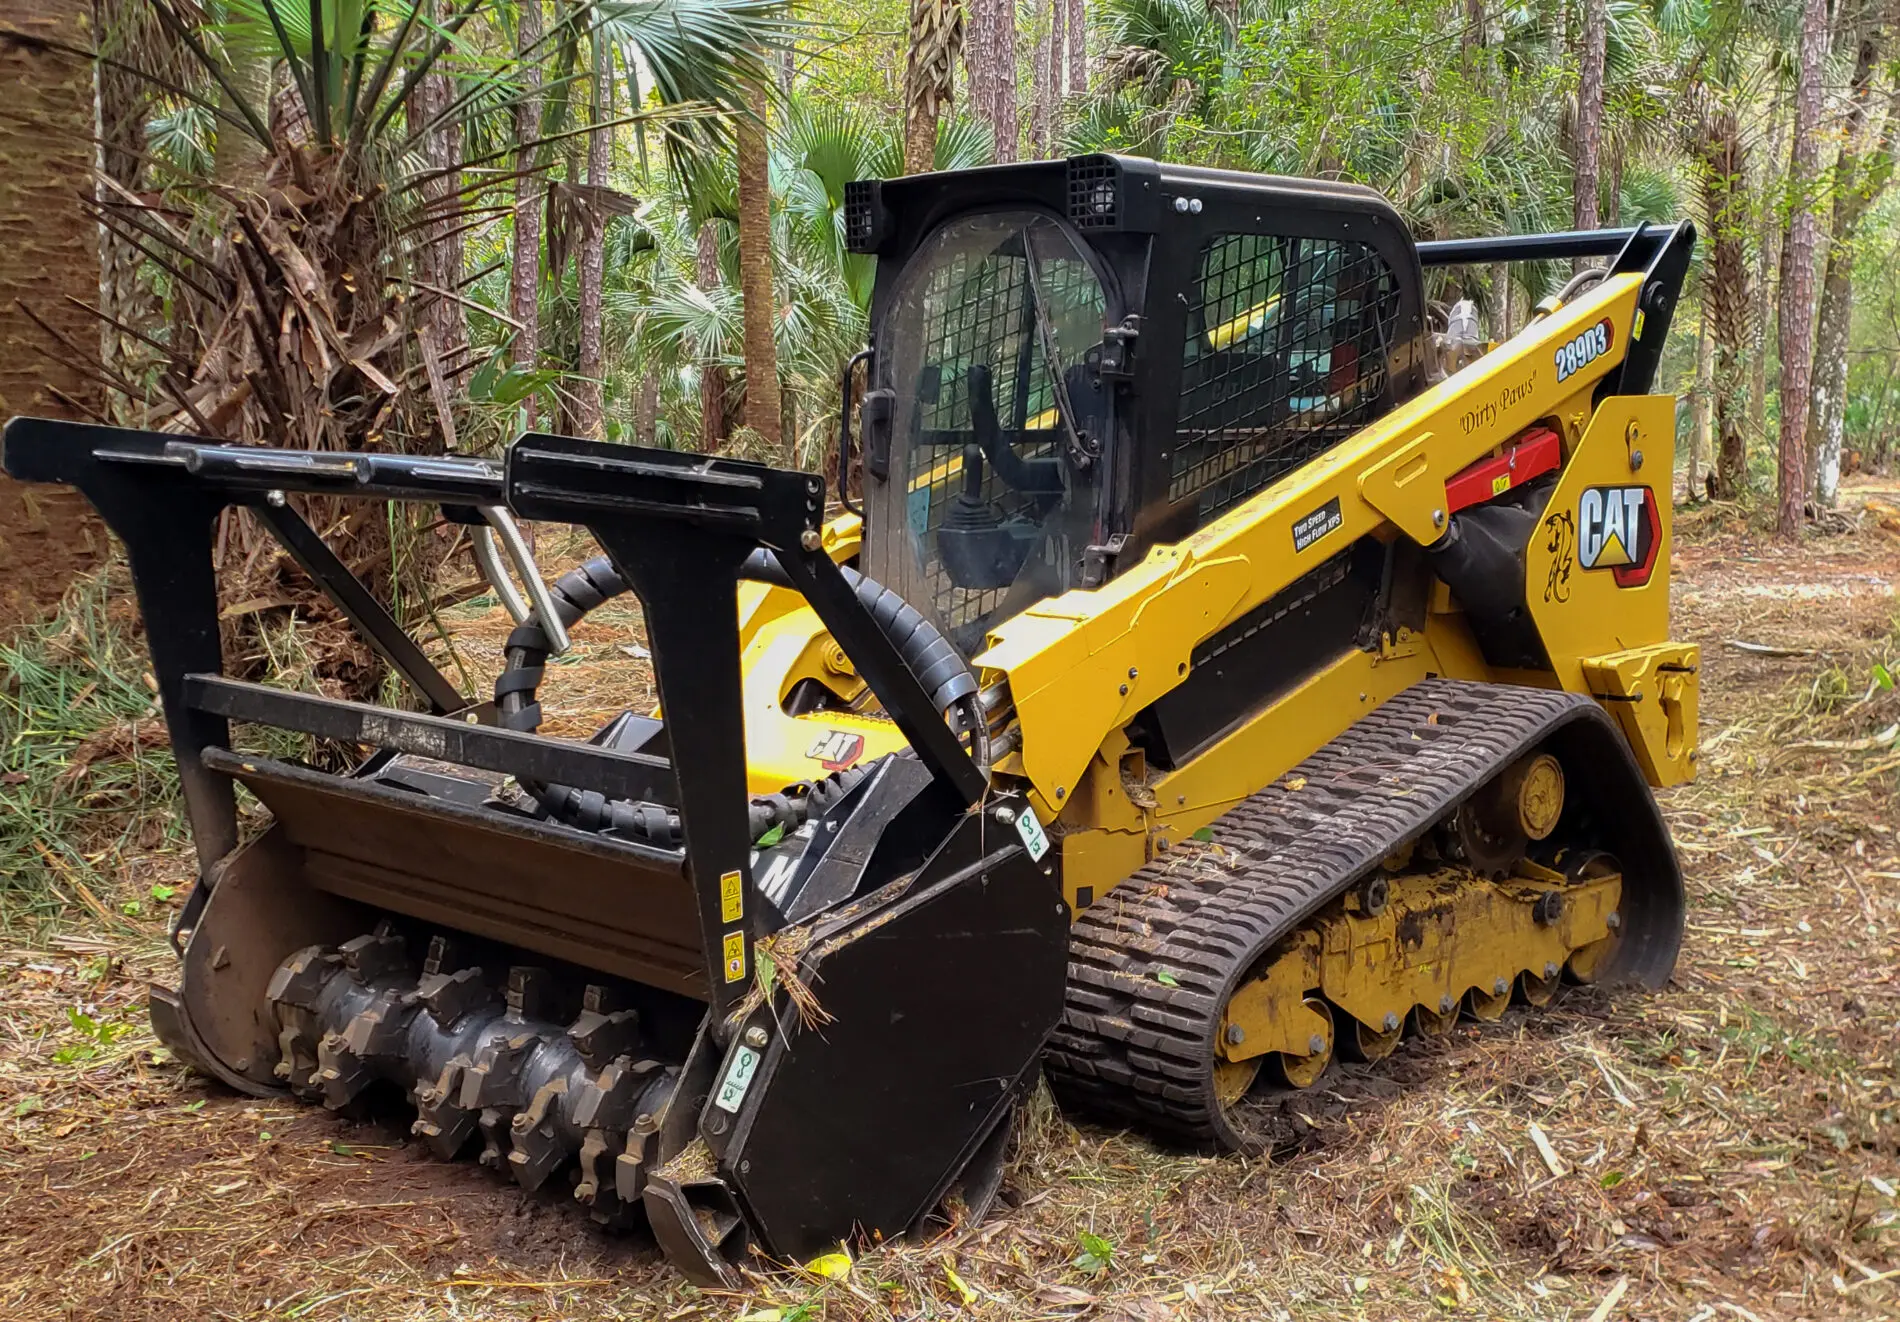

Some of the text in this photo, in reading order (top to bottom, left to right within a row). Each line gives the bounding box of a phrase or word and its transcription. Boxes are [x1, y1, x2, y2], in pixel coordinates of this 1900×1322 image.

[1555, 322, 1606, 382] 289D3
[1327, 513, 1340, 530] XPS
[1580, 488, 1645, 568] CAT
[805, 729, 860, 763] CAT
